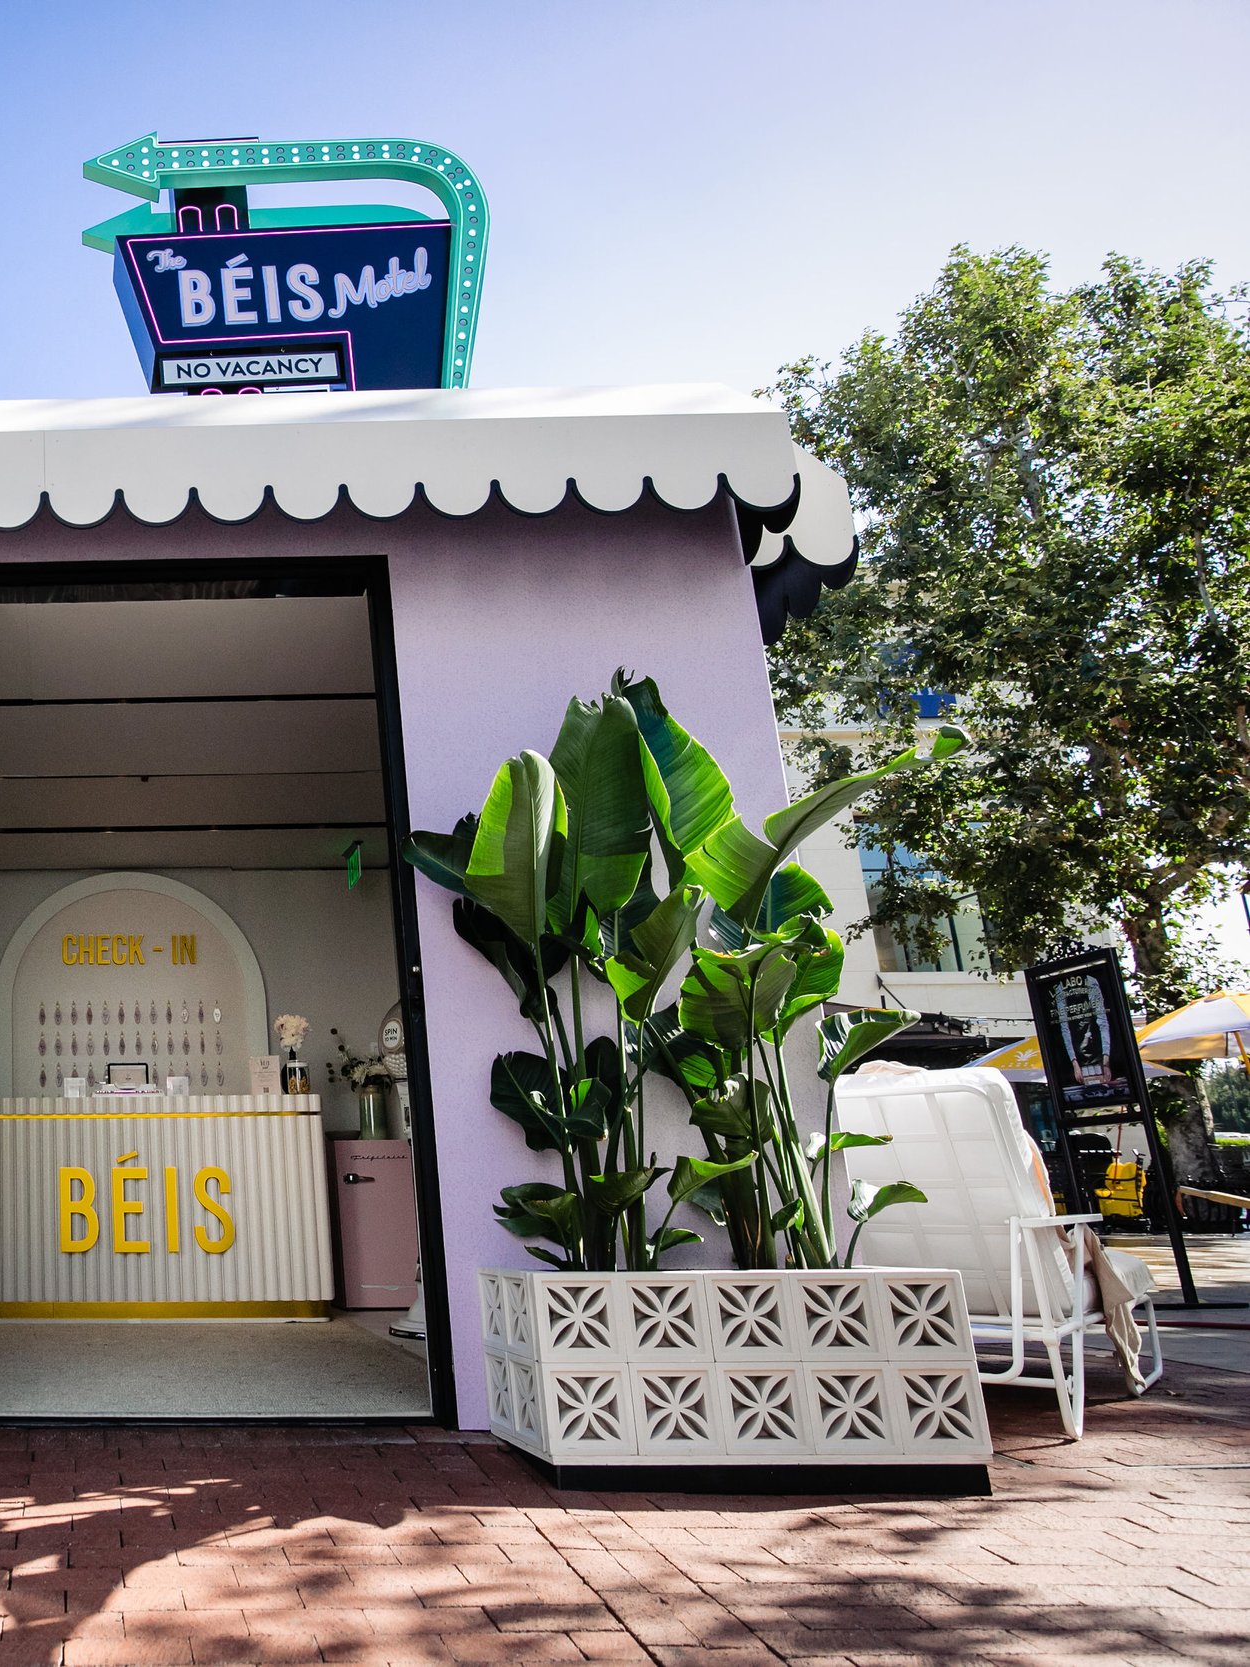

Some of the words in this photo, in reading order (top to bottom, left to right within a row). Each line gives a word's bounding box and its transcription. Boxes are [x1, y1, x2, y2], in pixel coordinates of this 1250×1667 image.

[146, 248, 188, 273] The
[177, 253, 325, 327] BÉIS
[327, 246, 433, 320] Motel
[176, 360, 211, 380] NO
[215, 357, 324, 377] VACANCY
[61, 933, 146, 966] CHECK
[171, 933, 198, 965] IN
[1060, 975, 1083, 990] LABO
[384, 1027, 398, 1037] SPIN
[58, 1150, 236, 1255] BÉIS
